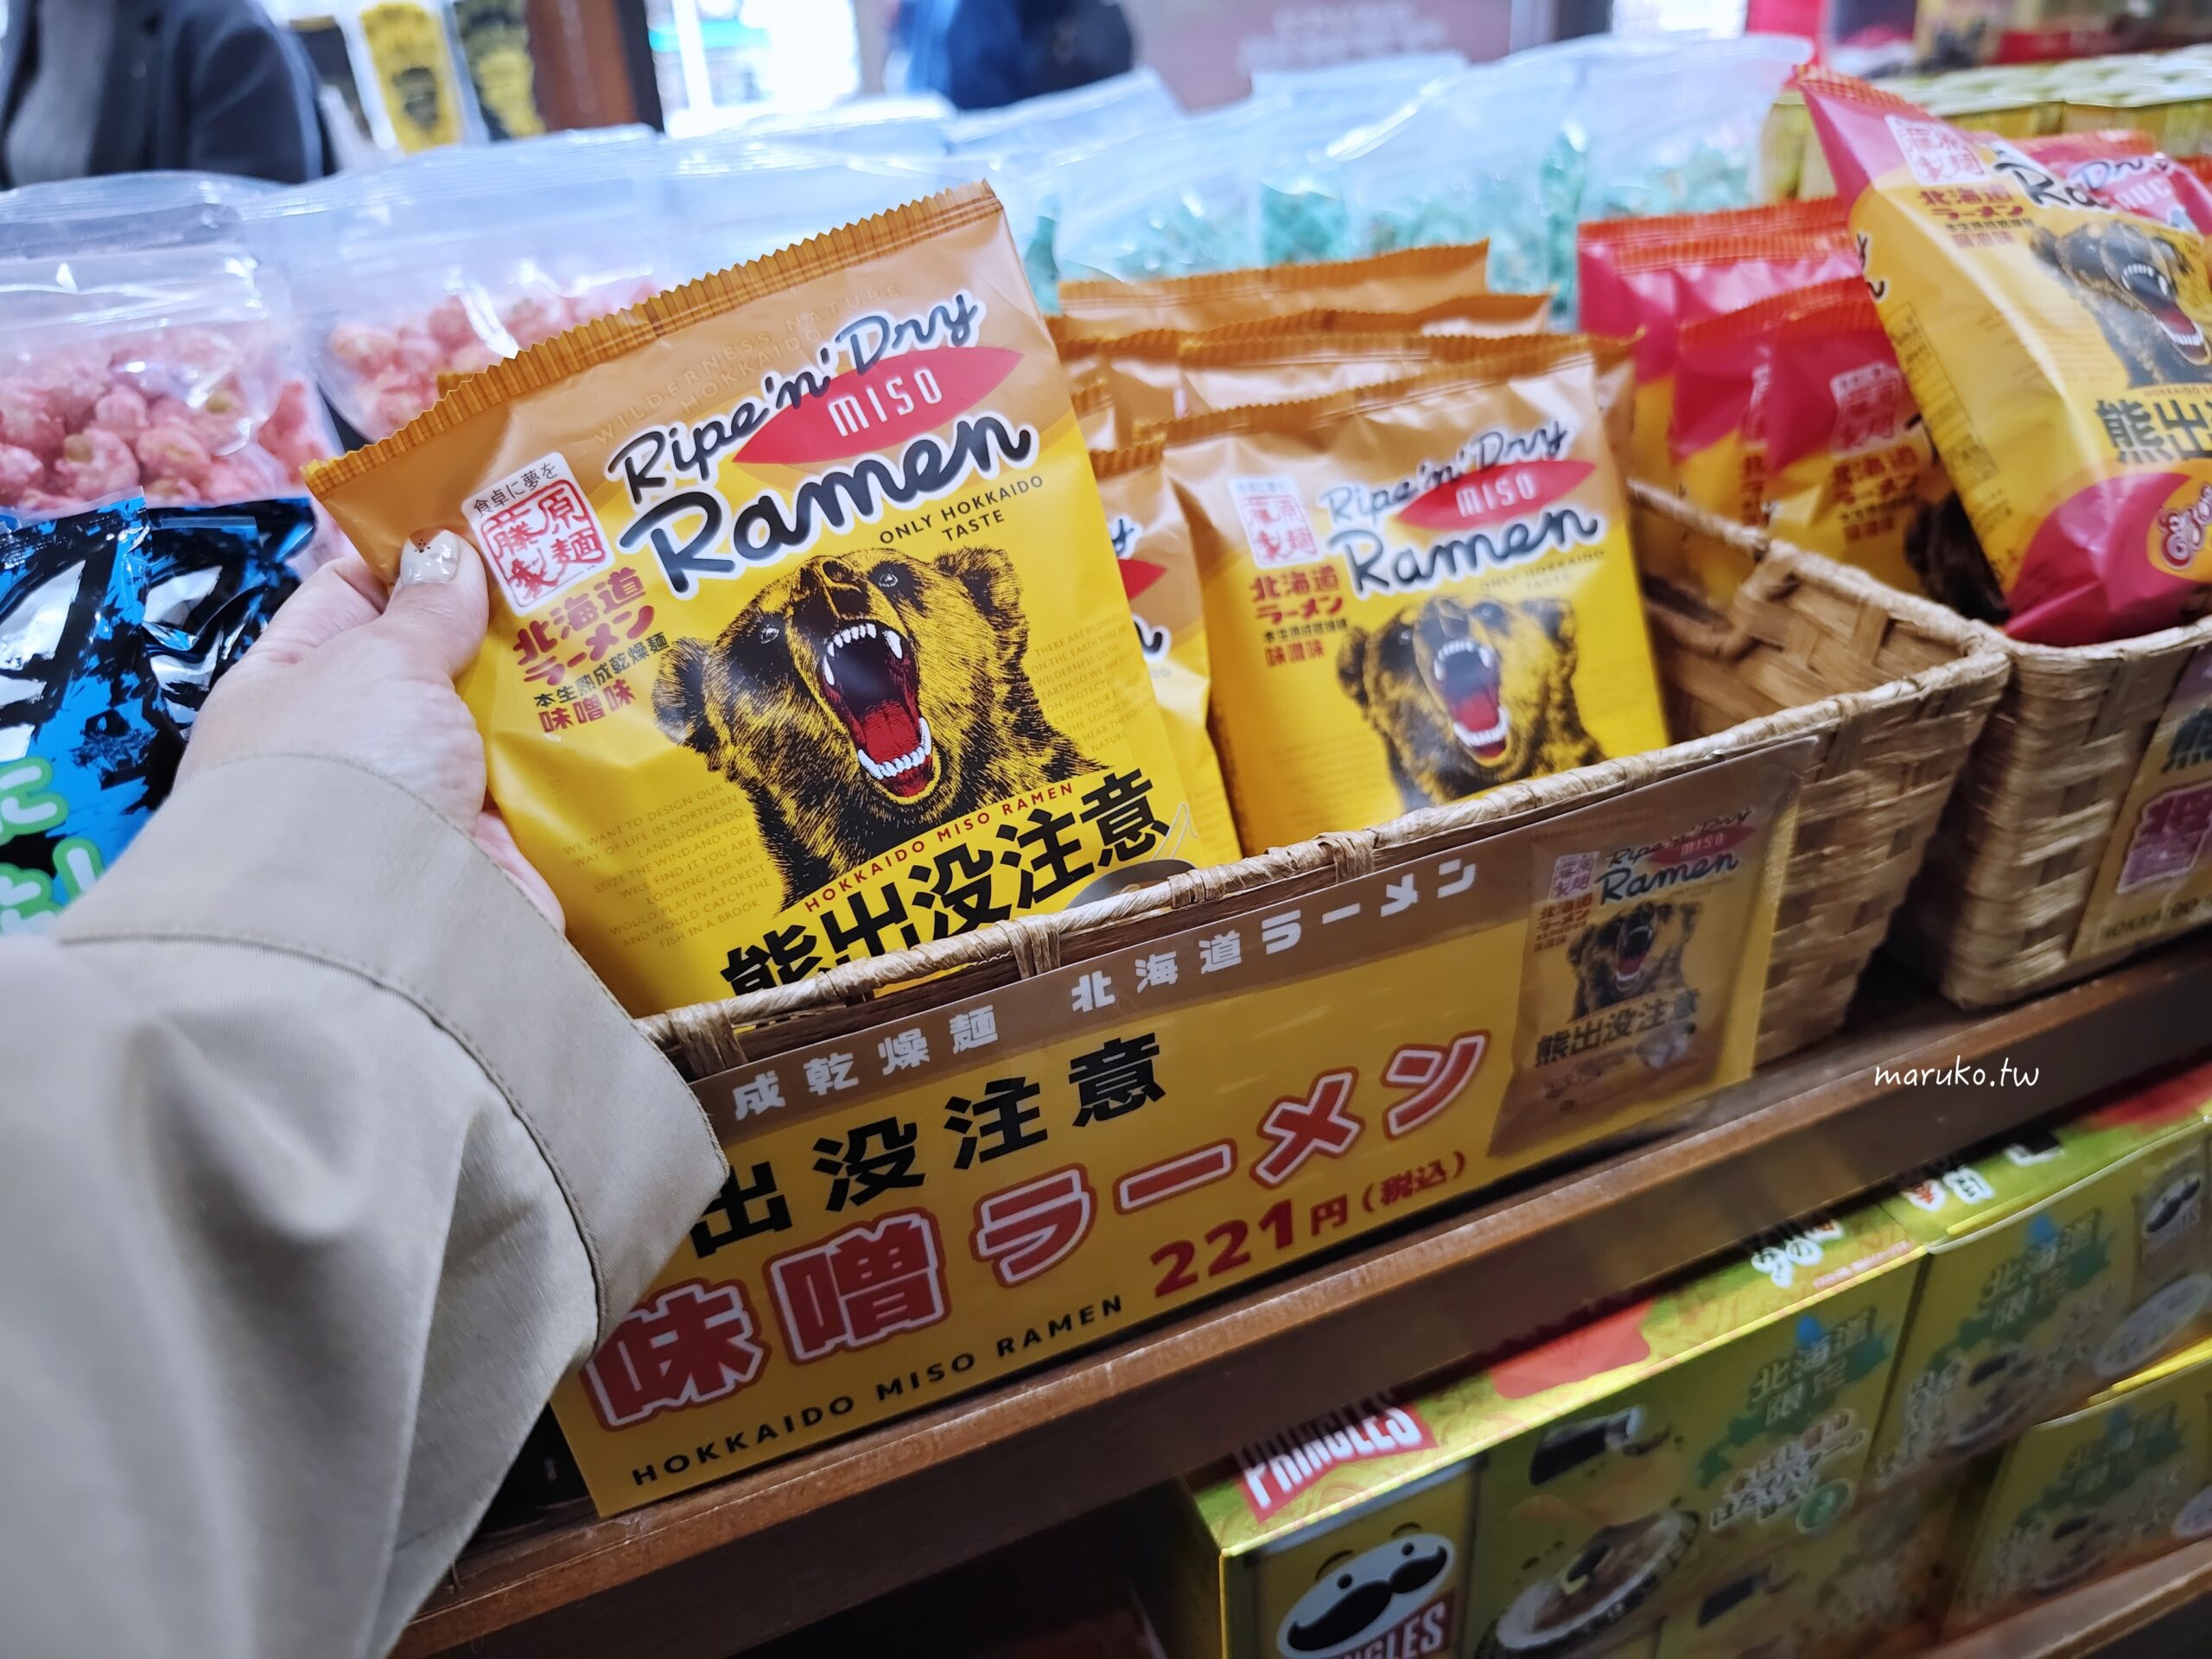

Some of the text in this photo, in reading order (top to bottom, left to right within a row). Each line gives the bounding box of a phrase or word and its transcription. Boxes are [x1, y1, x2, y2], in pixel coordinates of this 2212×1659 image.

[785, 283, 904, 334] NATURE
[827, 367, 943, 438] MISO
[473, 462, 559, 518] 食卓に夢を
[619, 416, 1033, 594] Ramen
[879, 475, 1045, 544] ONLY HOKKAIDO
[1455, 473, 1536, 517] MISO
[941, 514, 1006, 543] TASTE
[1326, 508, 1599, 594] Ramen
[1249, 563, 1340, 604] 北海道
[1255, 596, 1343, 626] ラーメン
[513, 567, 647, 666] 北海道
[524, 605, 655, 687] ラーメン
[1034, 638, 1065, 658] THERE
[1035, 656, 1096, 687] WILDERNESS
[538, 678, 637, 734] 味噌味
[1041, 681, 1073, 701] EARTH
[1088, 704, 1120, 725] SOUND
[1082, 725, 1109, 742] HEAR
[624, 832, 649, 850] LIFE
[652, 824, 667, 836] IN
[670, 793, 739, 827] NORTHERN
[626, 817, 644, 830] TO
[647, 796, 693, 822] DESIGN
[696, 783, 724, 800] OUR
[629, 863, 652, 879] THE
[722, 822, 749, 838] YOU
[638, 838, 672, 858] LAND
[653, 867, 684, 885] FIND
[688, 860, 699, 871] IT
[702, 849, 728, 864] YOU
[731, 836, 753, 852] ARE
[804, 783, 1075, 913] HOKKAIDO MISO RAMEN
[610, 863, 766, 936] WOULD PLAY IN A FOREST
[645, 851, 756, 906] LOOKING FOR WE
[1594, 852, 1739, 906] Ramen
[623, 877, 772, 947] AND WOULD CATCH THE
[659, 931, 686, 950] FISH
[689, 925, 703, 938] IN
[707, 919, 715, 929] A
[1071, 861, 1477, 1014] 北海道ラーメン
[581, 1028, 1491, 1432] 味噌ラーメン
[632, 1295, 1125, 1486] HOKKAIDO MISO RAMEN
